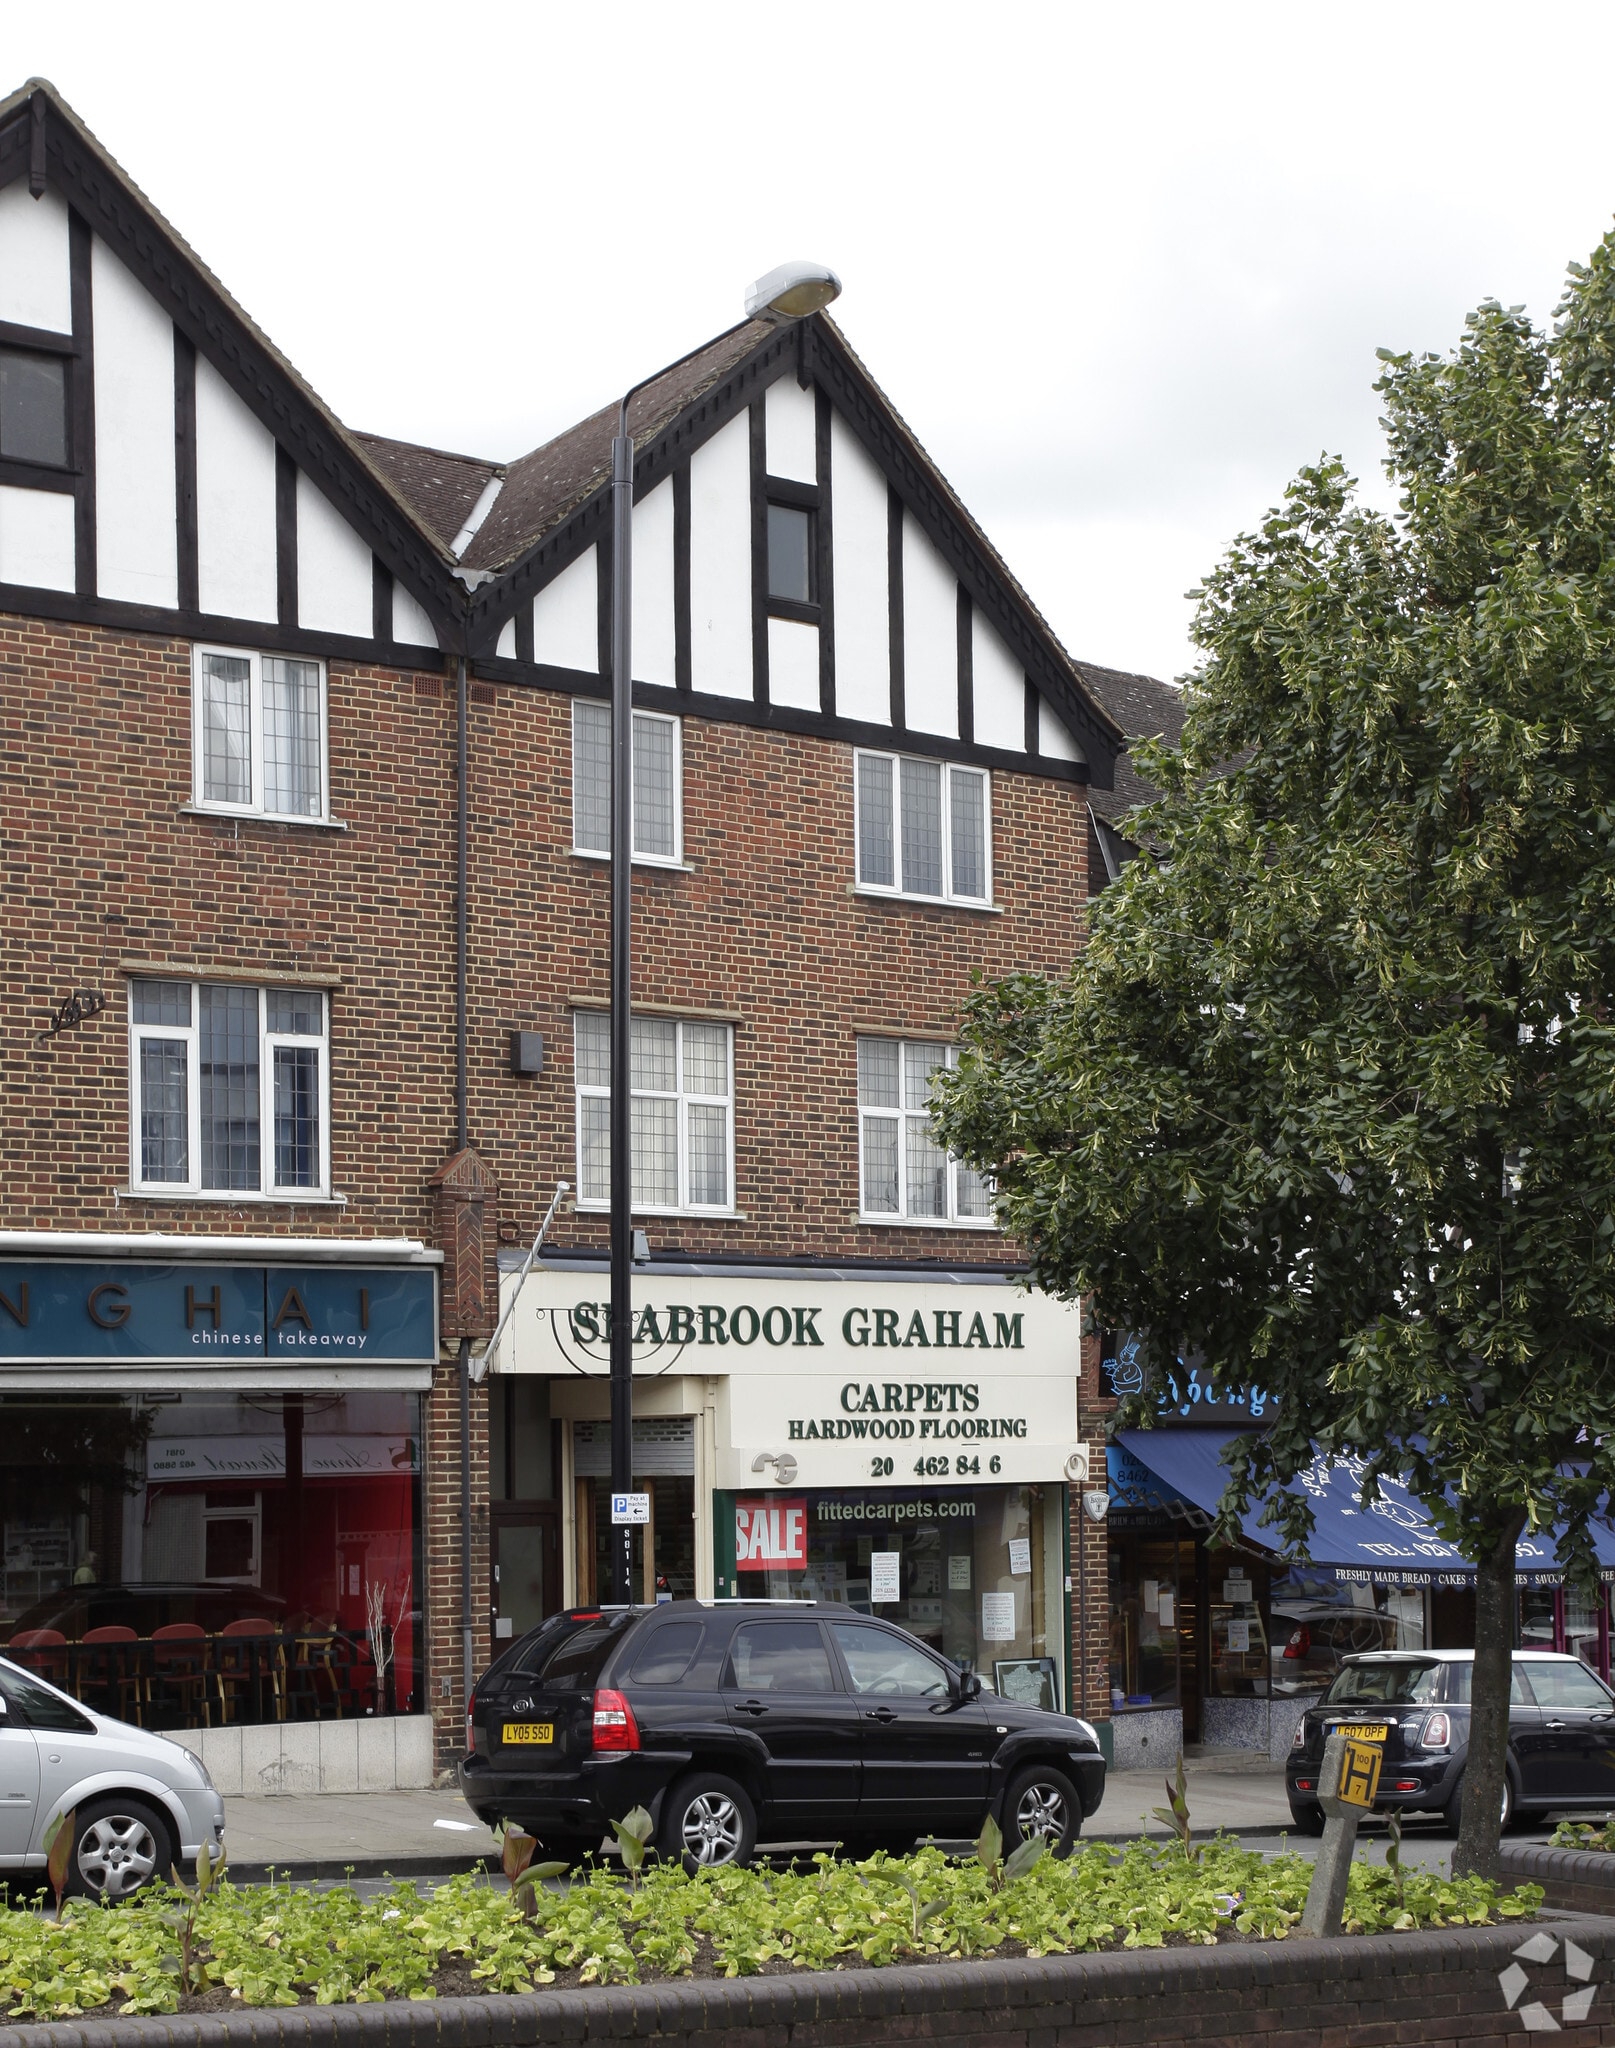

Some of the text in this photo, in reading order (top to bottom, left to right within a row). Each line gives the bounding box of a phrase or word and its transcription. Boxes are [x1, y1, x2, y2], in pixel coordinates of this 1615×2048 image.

[842, 1307, 1025, 1349] GRAHAM
[192, 1330, 368, 1349] chinese takeaway
[840, 1382, 980, 1413] CARPETS
[788, 1418, 1028, 1440] HARDWOOD FLOORING
[871, 1456, 894, 1477] 20
[914, 1456, 949, 1477] 462
[989, 1455, 1002, 1474] 6
[1117, 1470, 1149, 1482] 8462
[816, 1501, 976, 1522] fittedcarpets.com
[736, 1508, 803, 1561] SALE
[1357, 1543, 1416, 1557] TEL:
[1412, 1543, 1452, 1557] 020
[1335, 1568, 1372, 1582] FRESHLY
[1374, 1572, 1400, 1583] MADE
[1402, 1572, 1431, 1584] BREAD
[1438, 1574, 1466, 1585] CAKES
[506, 1726, 529, 1740] LY05
[1356, 1754, 1370, 1765] 100
[1343, 1749, 1376, 1801] H
[1355, 1784, 1361, 1795] 7
